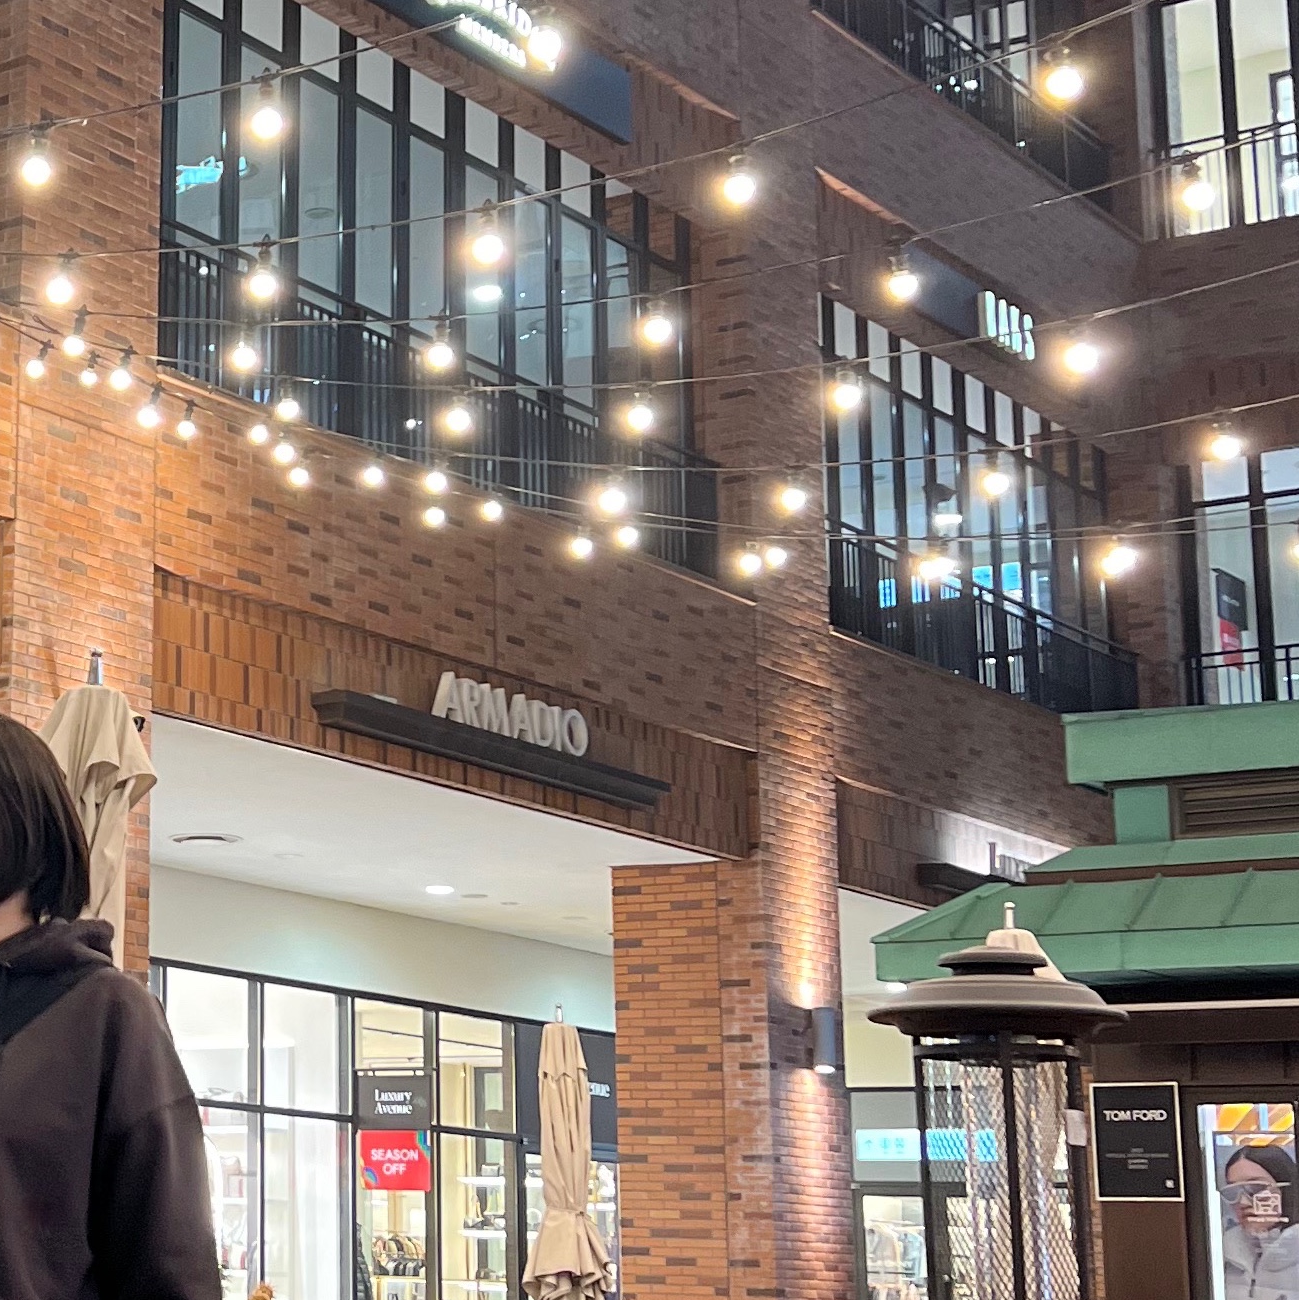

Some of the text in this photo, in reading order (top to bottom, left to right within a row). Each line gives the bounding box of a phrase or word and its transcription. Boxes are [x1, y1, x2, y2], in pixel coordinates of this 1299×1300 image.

[431, 671, 590, 757] ARMADIO
[374, 1088, 412, 1104] Luxury
[374, 1102, 413, 1115] Avenue
[1102, 1109, 1168, 1121] TOM FORD
[370, 1149, 419, 1161] SEASON
[382, 1163, 407, 1175] OFF
